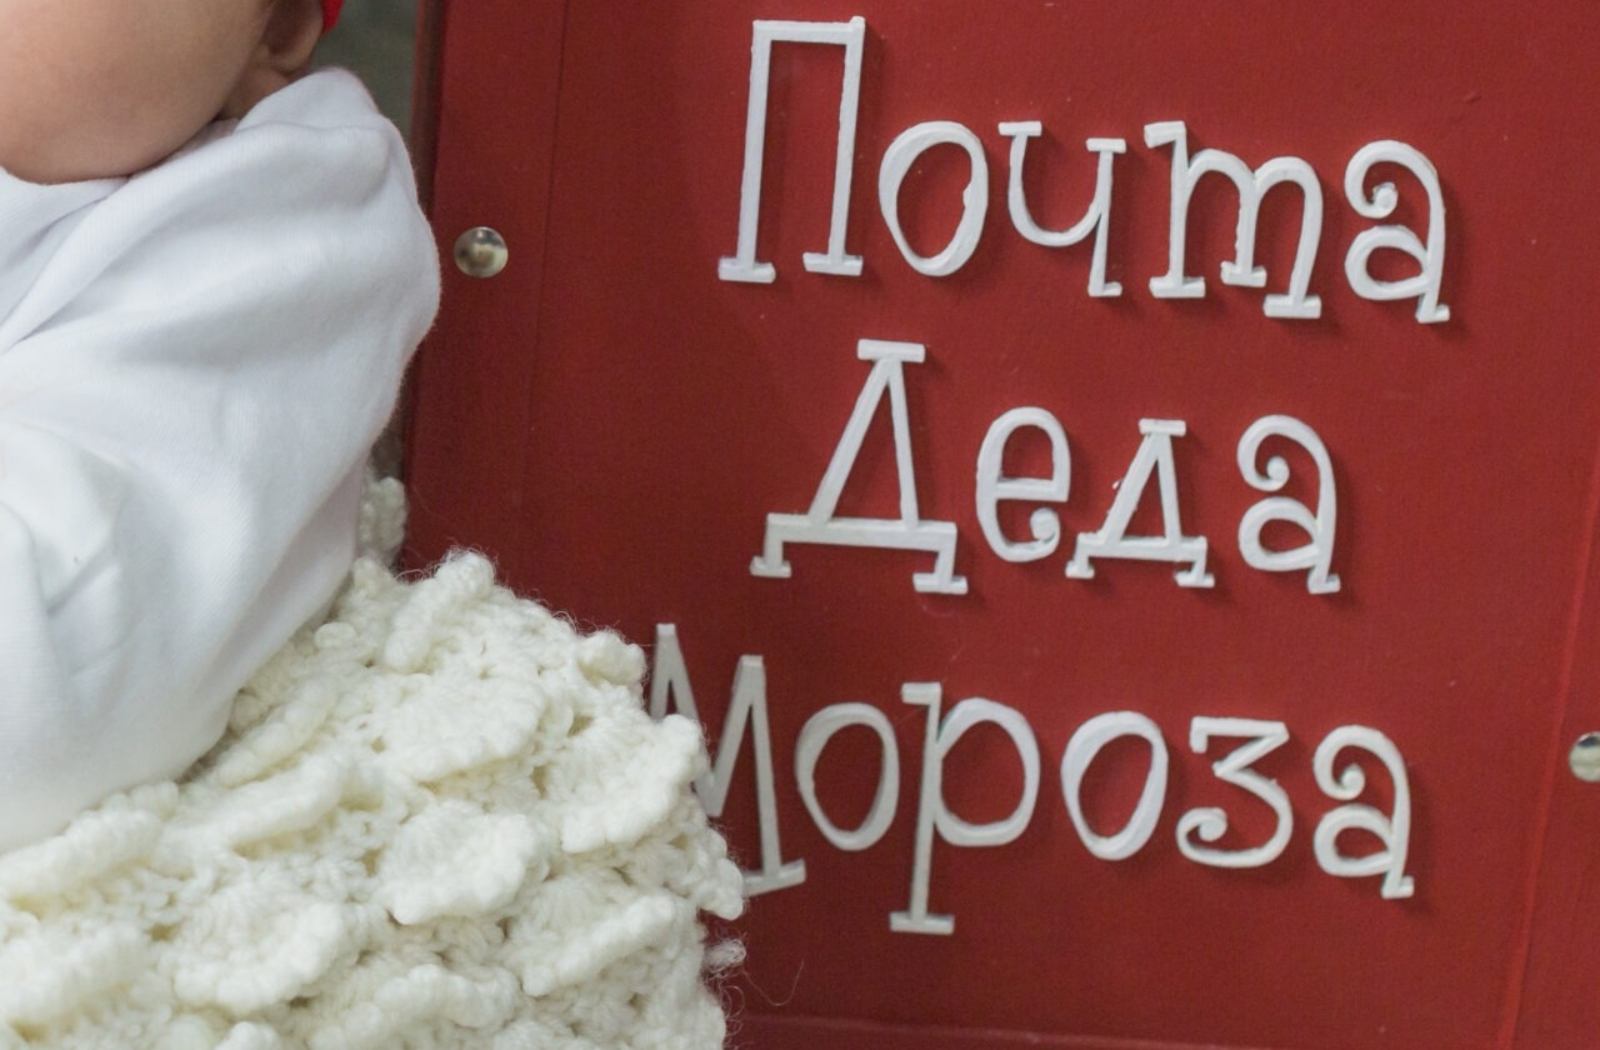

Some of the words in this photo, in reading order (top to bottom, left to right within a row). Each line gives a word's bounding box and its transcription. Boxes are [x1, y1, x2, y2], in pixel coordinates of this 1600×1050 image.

[718, 16, 1449, 323] Почта
[750, 339, 1339, 594] Деда
[650, 623, 1413, 934] Мороза
